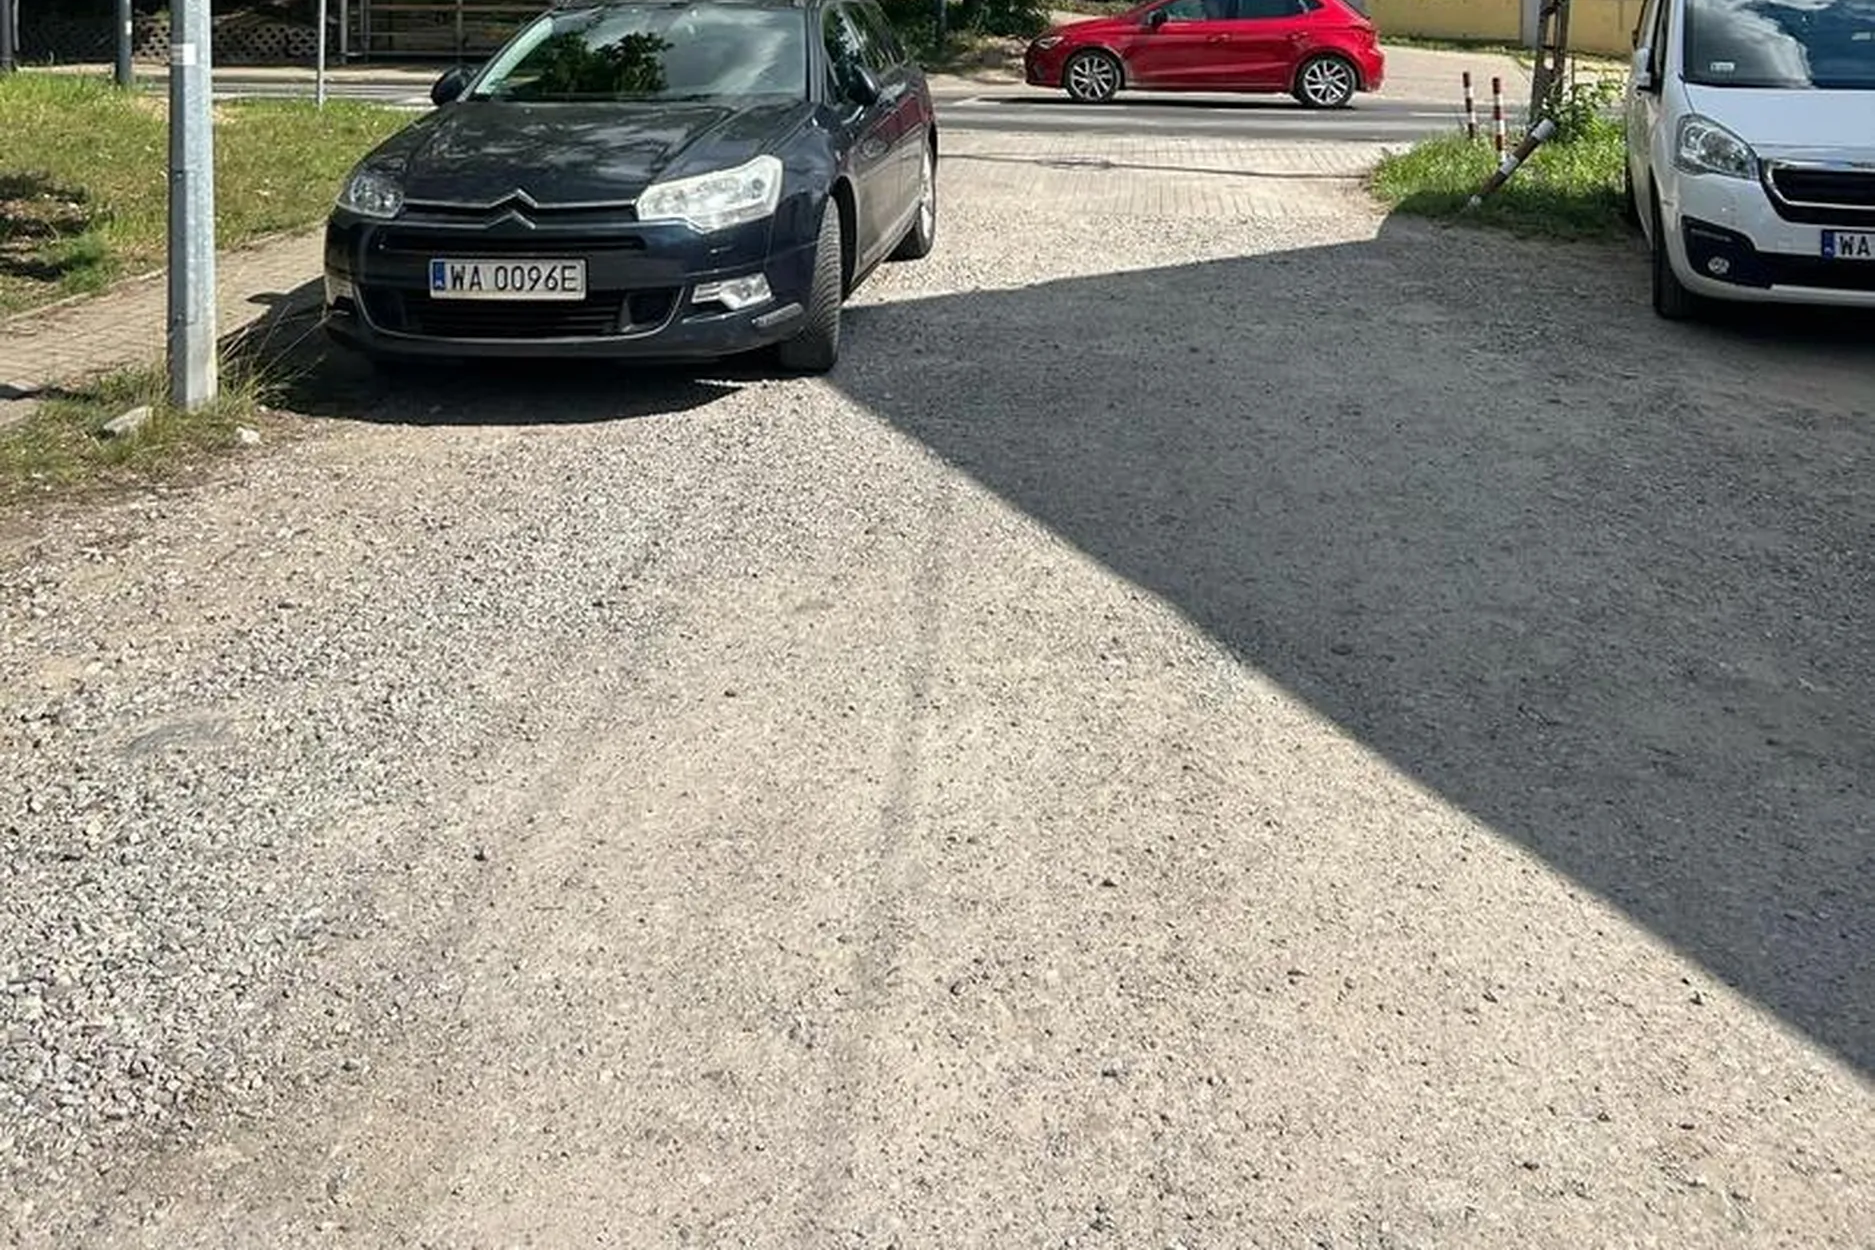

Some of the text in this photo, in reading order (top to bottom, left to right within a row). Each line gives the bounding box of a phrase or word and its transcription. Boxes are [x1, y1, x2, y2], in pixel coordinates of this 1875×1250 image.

[1839, 235, 1871, 256] WA
[451, 265, 577, 291] WA 0096E
